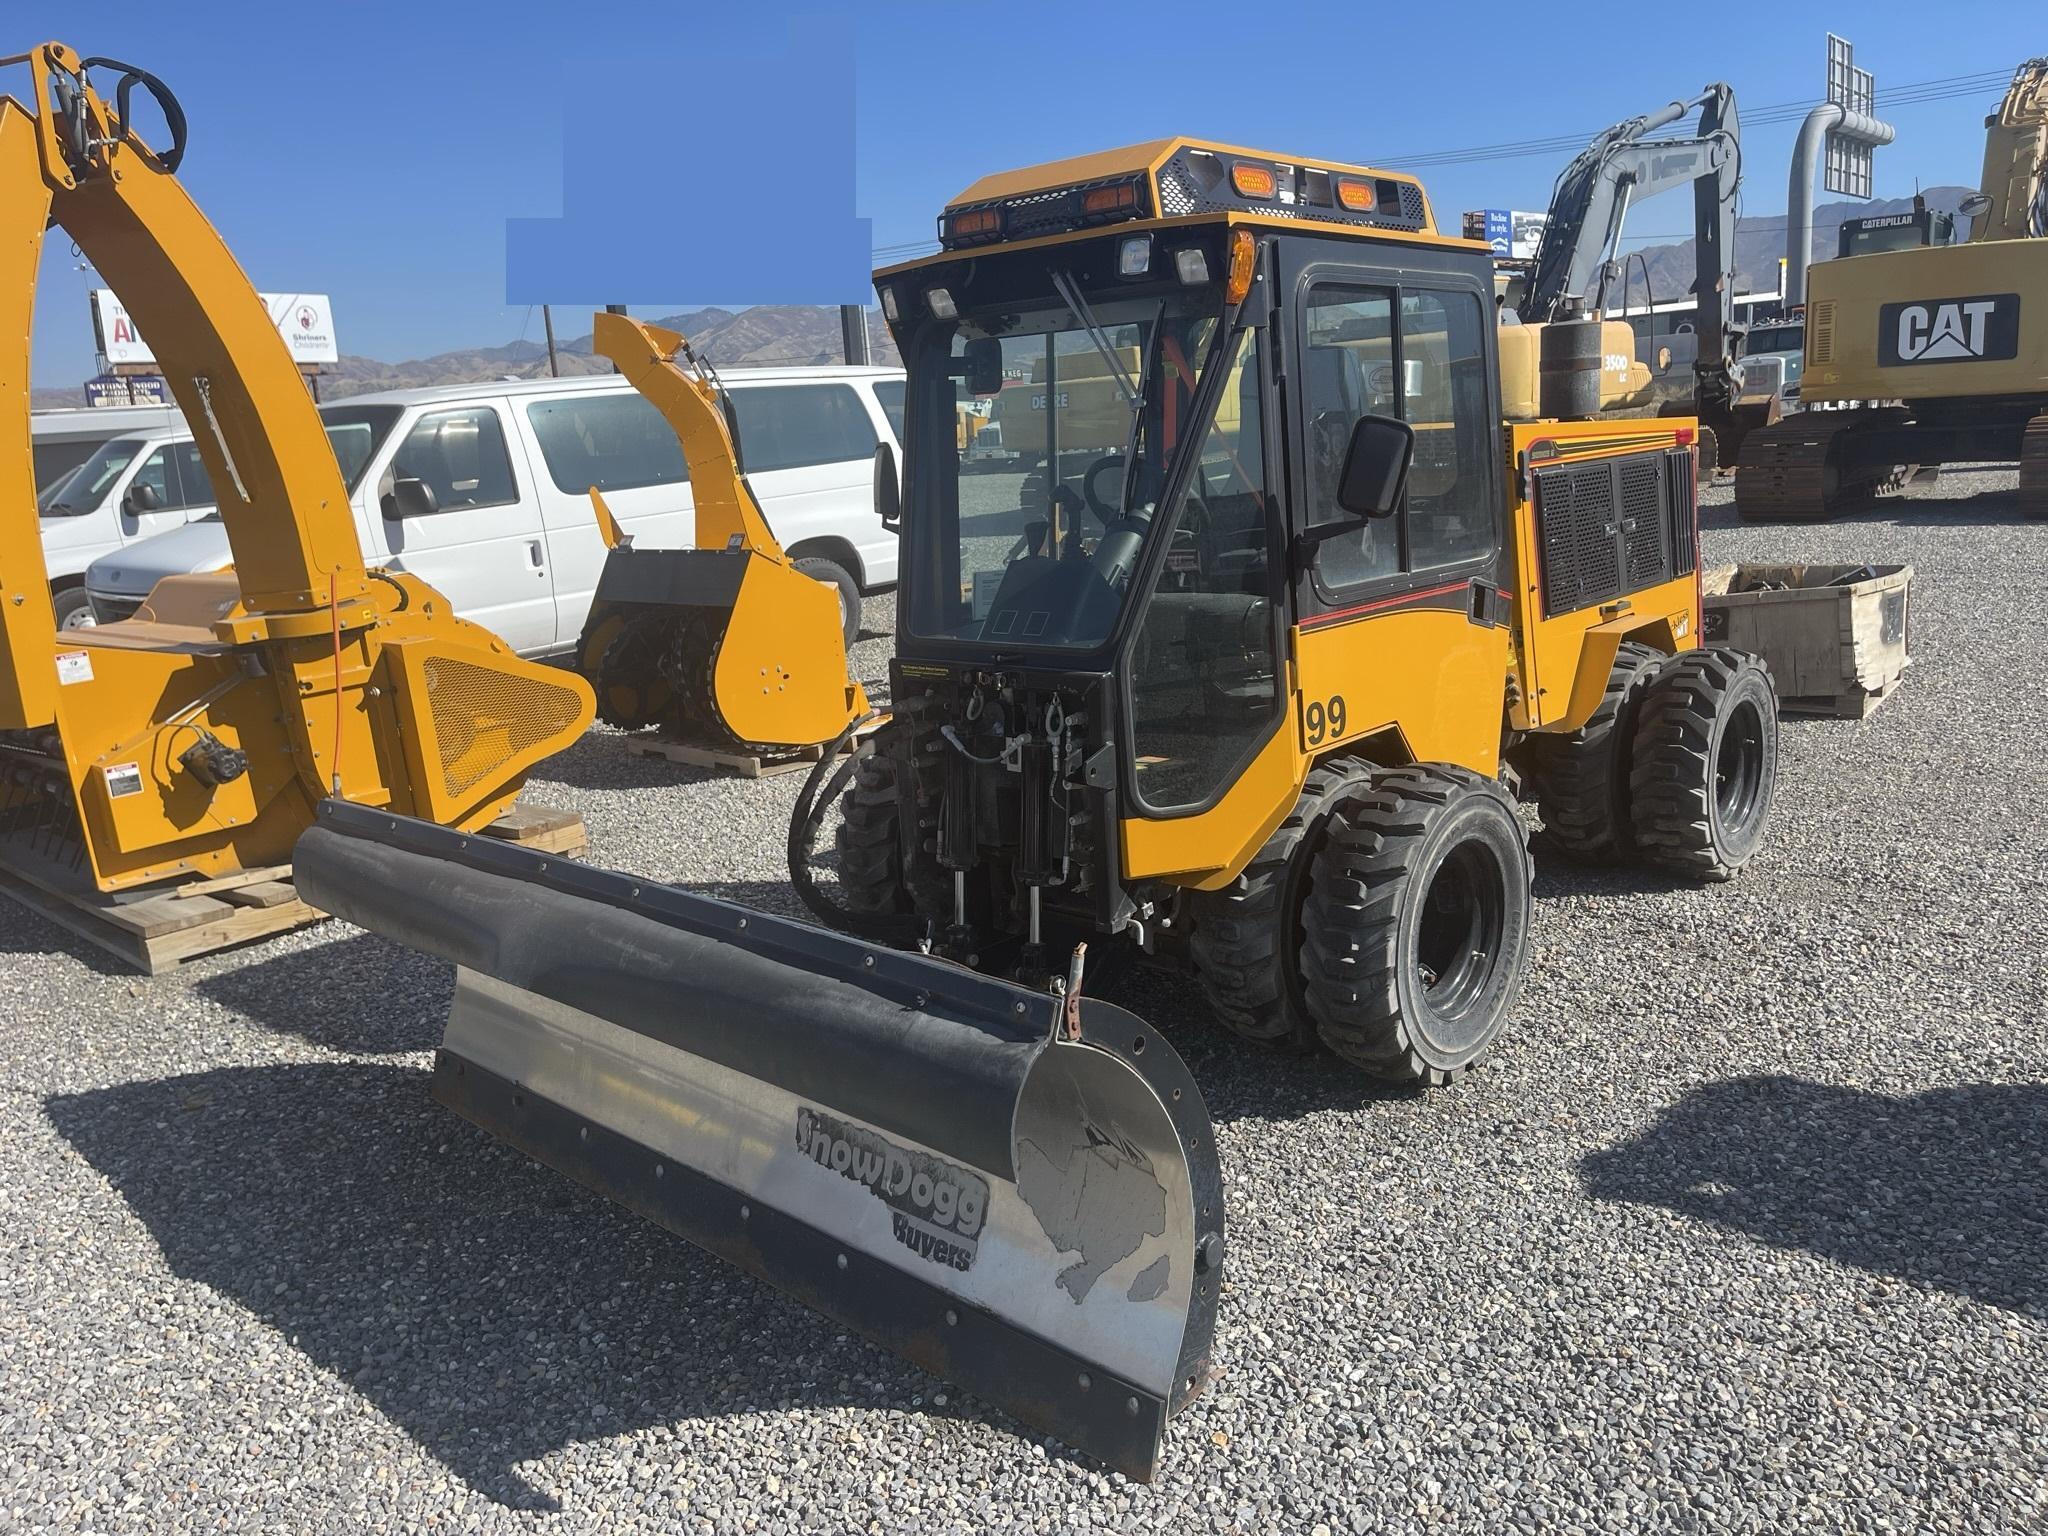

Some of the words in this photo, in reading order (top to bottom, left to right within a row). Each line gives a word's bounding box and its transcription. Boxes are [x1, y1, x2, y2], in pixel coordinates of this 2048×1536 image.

[1861, 215, 1913, 229] CATERPILLAR
[293, 333, 327, 341] Shriners
[1897, 301, 1996, 361] CAT
[1008, 369, 1022, 378] KEG
[89, 382, 129, 391] NATIONA
[1031, 393, 1069, 410] DERE
[1306, 695, 1346, 745] 99
